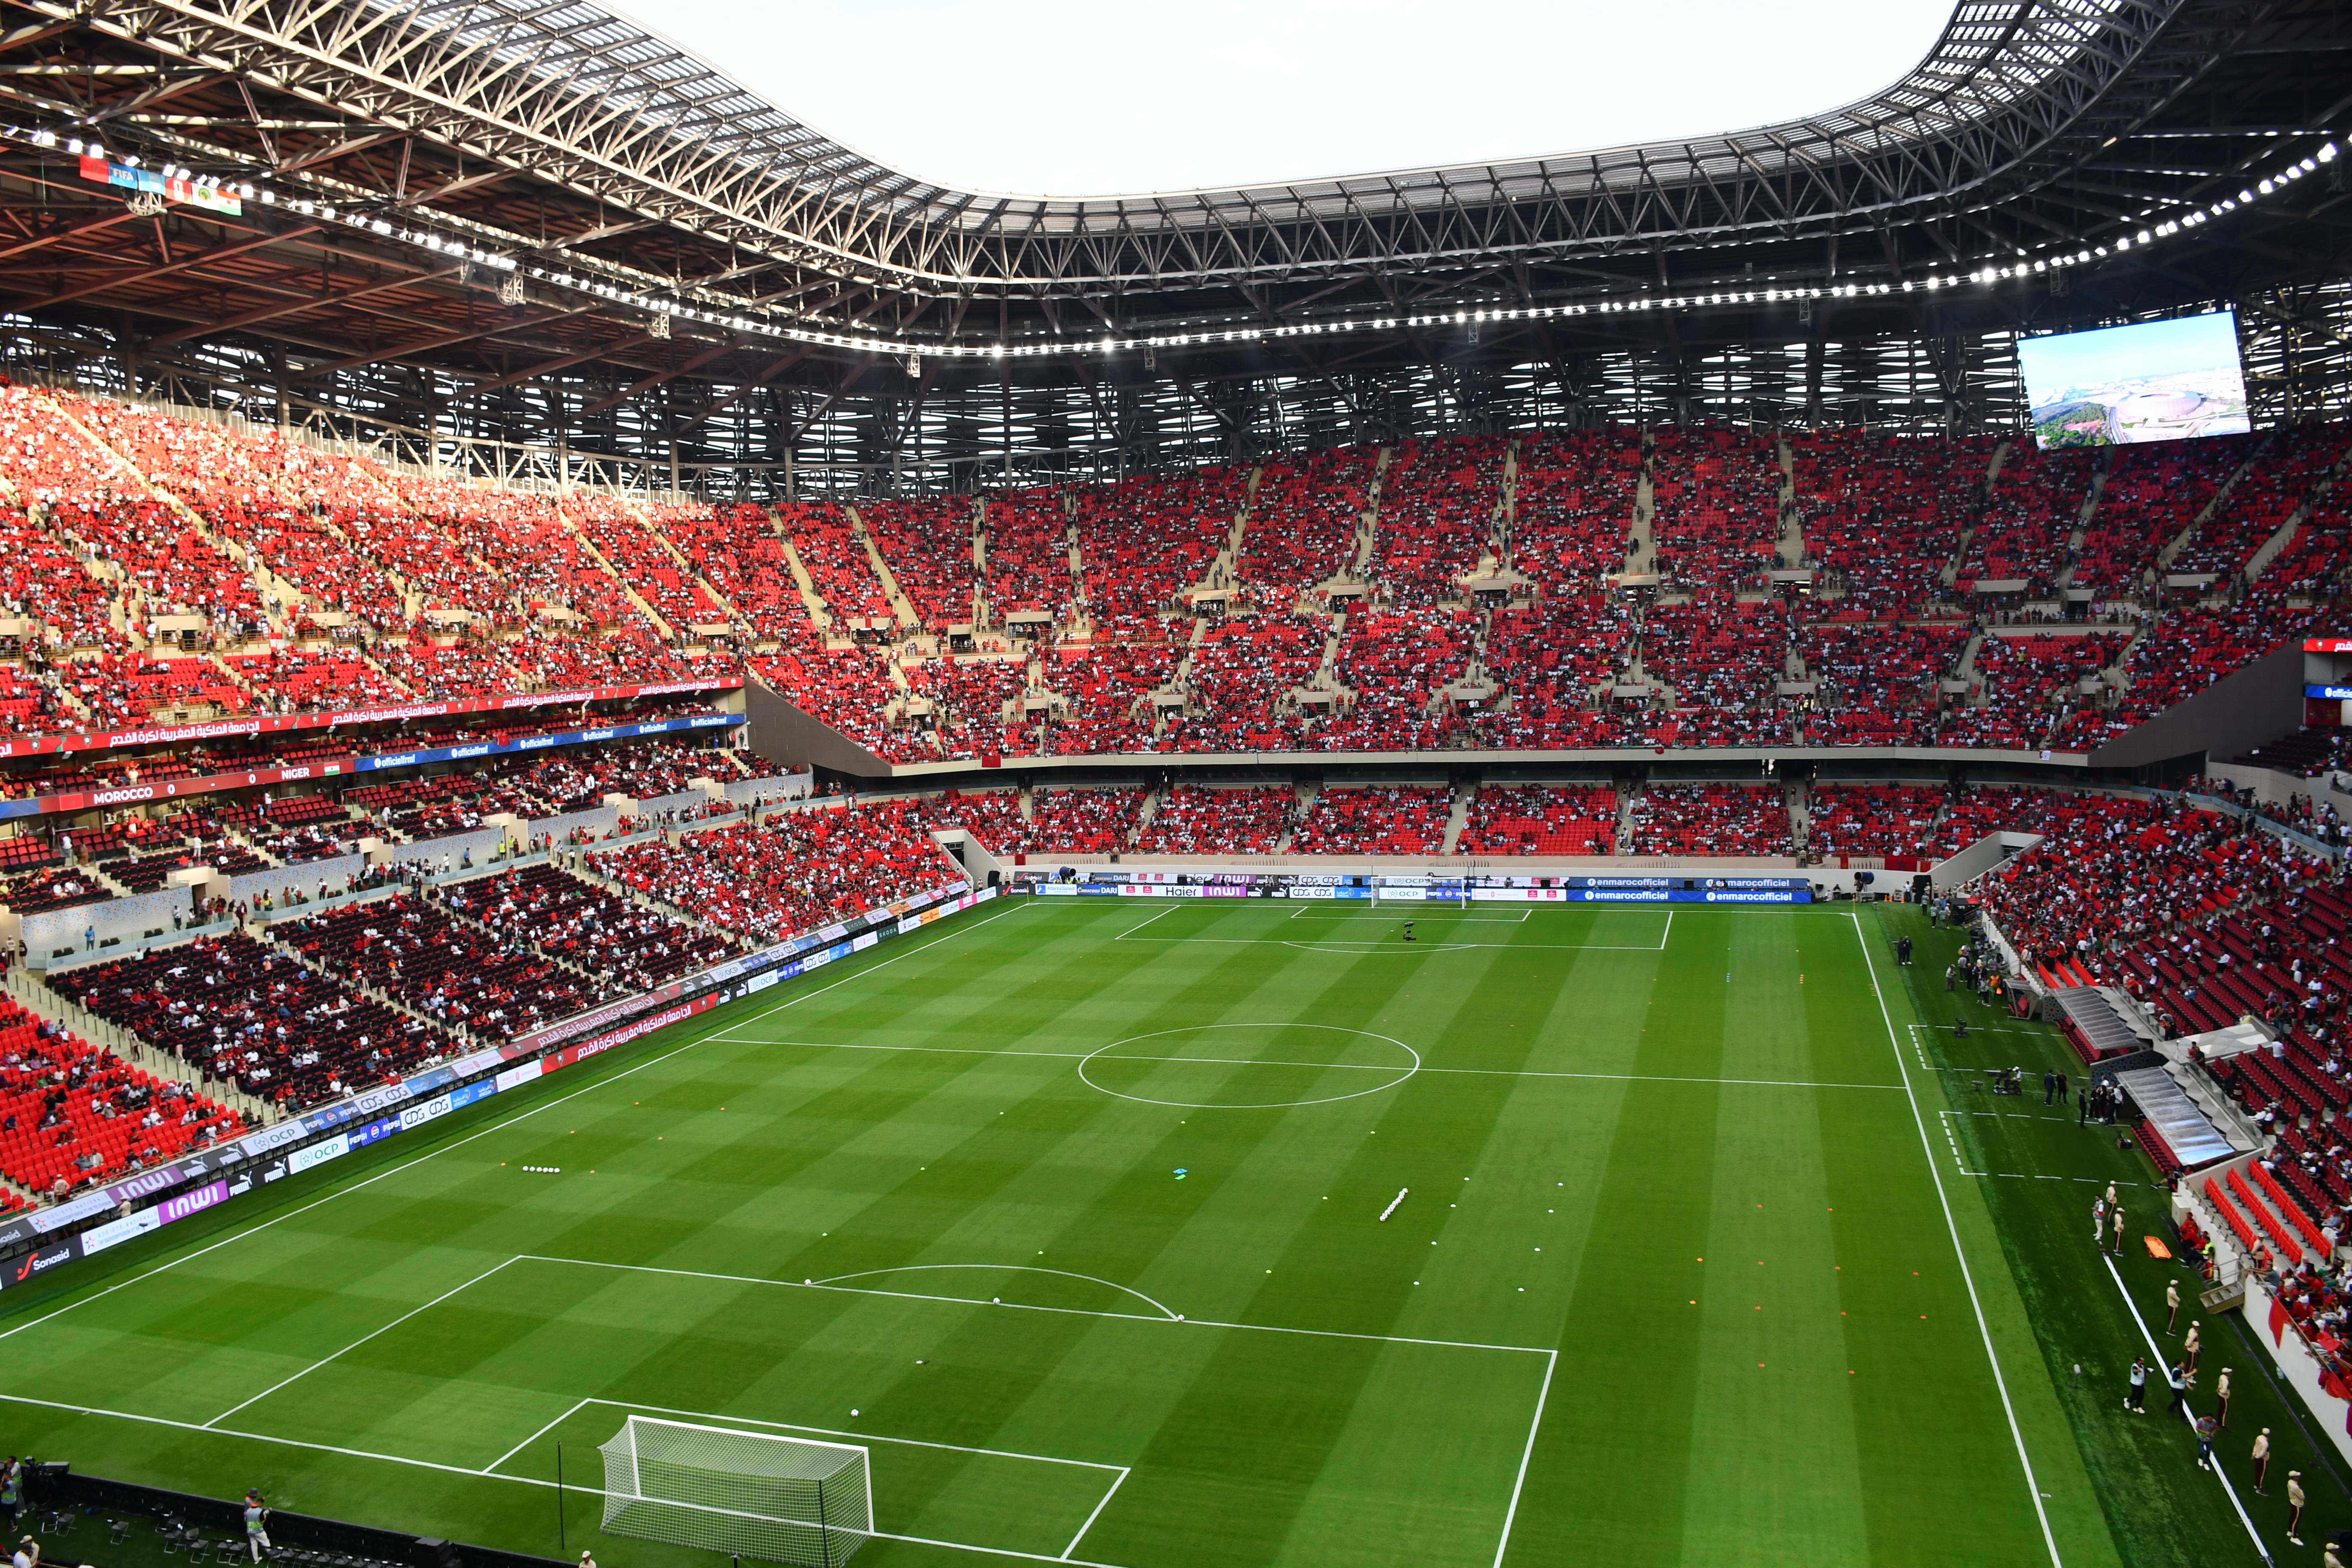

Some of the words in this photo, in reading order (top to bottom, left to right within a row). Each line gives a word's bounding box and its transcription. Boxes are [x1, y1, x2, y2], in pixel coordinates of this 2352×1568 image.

[113, 169, 134, 181] FIFA
[370, 709, 397, 721] المغربية
[398, 707, 422, 718] الملكية
[422, 704, 447, 715] الجامعة
[332, 713, 353, 725] القدم
[354, 711, 369, 723] لكرة
[197, 724, 227, 738] الملكية
[228, 721, 259, 733] الجامعة
[110, 732, 137, 747] القدم
[139, 730, 158, 743] لكرة
[160, 727, 196, 741] المغربية
[458, 745, 488, 757] officielfrmf
[381, 754, 416, 767] officielfrmf
[94, 787, 153, 805] MOROCCO
[168, 784, 175, 795] 0
[249, 774, 256, 784] 0
[281, 767, 310, 780] NIGER
[1166, 887, 1196, 896] Haier
[1595, 891, 1668, 899] enmarocofficiel
[1717, 893, 1792, 901] enmarocofficiel
[725, 966, 738, 975] OCP
[761, 975, 773, 985] OCP
[386, 1087, 409, 1100] CDG
[361, 1096, 385, 1110] CDG
[429, 1099, 449, 1115] CDG
[339, 1107, 358, 1116] PEPSI
[405, 1108, 425, 1124] CDG
[305, 1118, 324, 1129] PEPSI
[383, 1120, 400, 1131] PEPSI
[270, 1128, 295, 1143] OCP
[349, 1132, 367, 1144] PEPSI
[315, 1143, 338, 1159] OCP
[0, 1230, 21, 1244] asid
[33, 1248, 70, 1271] Sonasid
